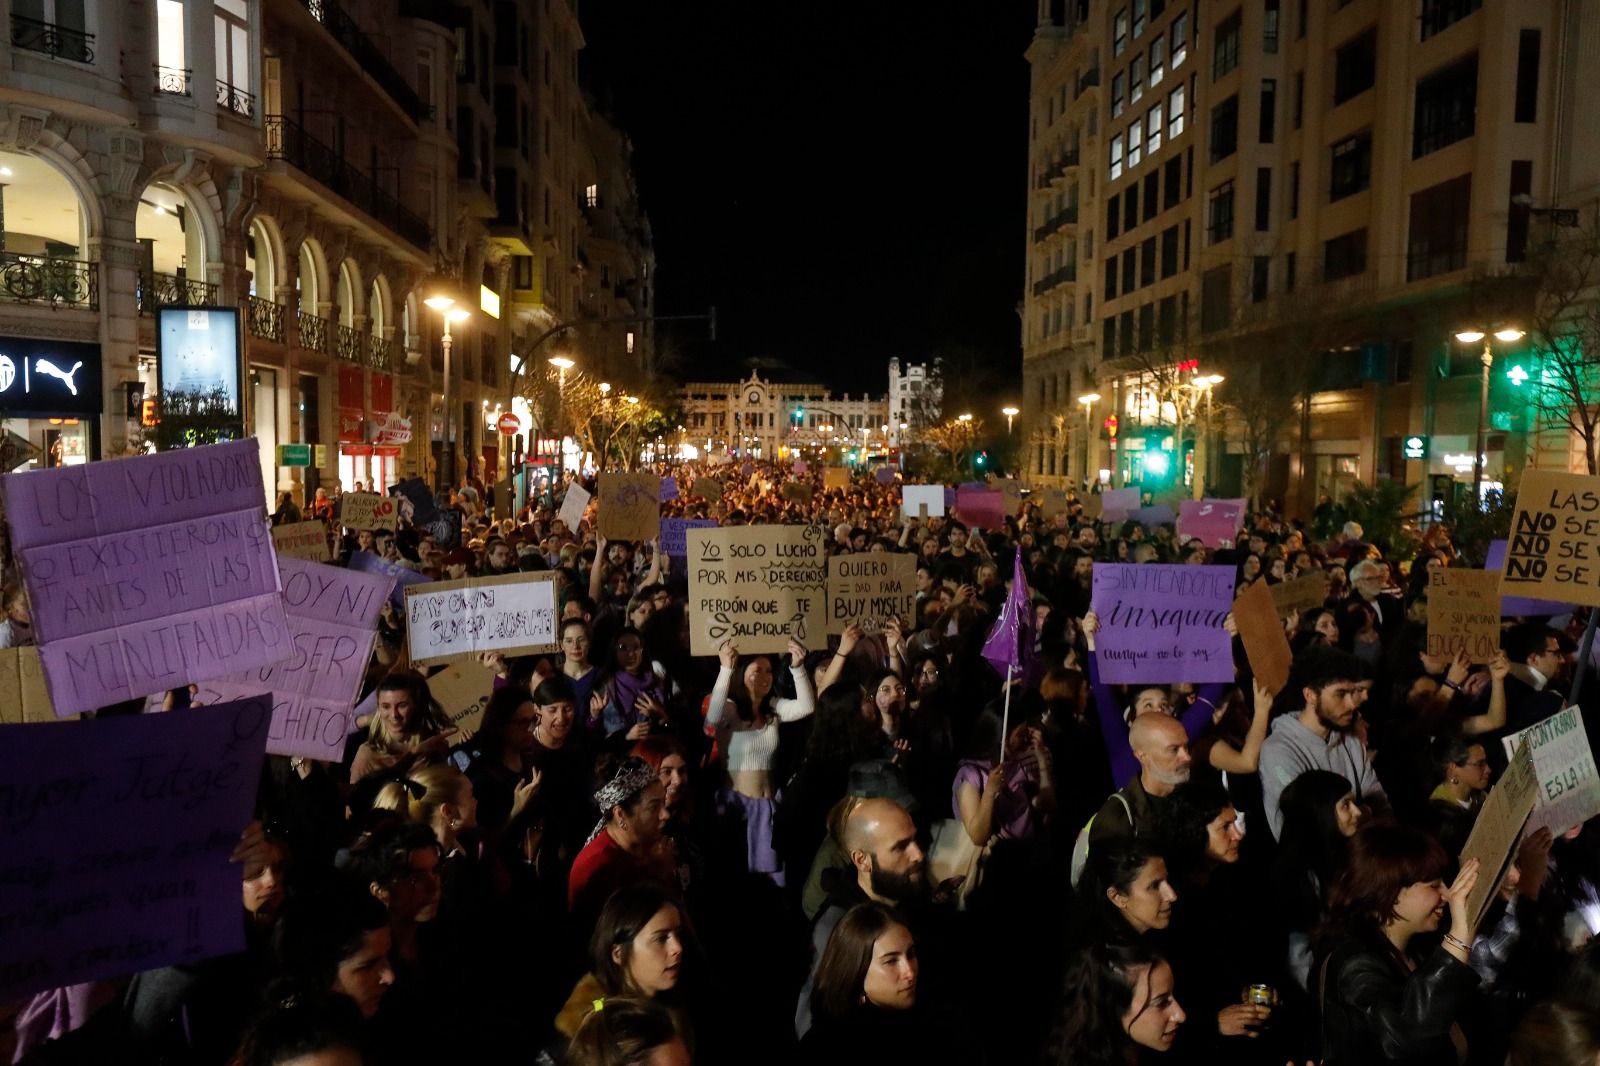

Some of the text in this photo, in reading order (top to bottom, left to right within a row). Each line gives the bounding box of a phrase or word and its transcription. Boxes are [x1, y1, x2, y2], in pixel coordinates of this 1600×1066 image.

[1549, 489, 1600, 512] LAS
[1516, 510, 1600, 536] NO SE
[67, 520, 239, 578] EXISTIERON
[730, 543, 766, 558] SOLO
[776, 543, 817, 558] LUCHO
[1511, 534, 1589, 560] NO SE
[698, 569, 824, 585] POR MIS DERECHOS
[839, 561, 888, 577] QUIERO
[1432, 572, 1447, 586] EL
[1506, 557, 1590, 584] NO SE
[64, 553, 251, 625] ANTES DE LAS
[281, 568, 377, 622] OY NI
[855, 584, 871, 593] DAD
[880, 581, 902, 593] PARA
[411, 589, 495, 624] MY OWN
[701, 595, 810, 615] PERDÓN QUE TE
[834, 595, 913, 619] BUY MYSELF
[730, 621, 791, 638] SALPIQUE
[65, 605, 282, 700] MINIFALDAS
[1545, 767, 1580, 801] ES LA
